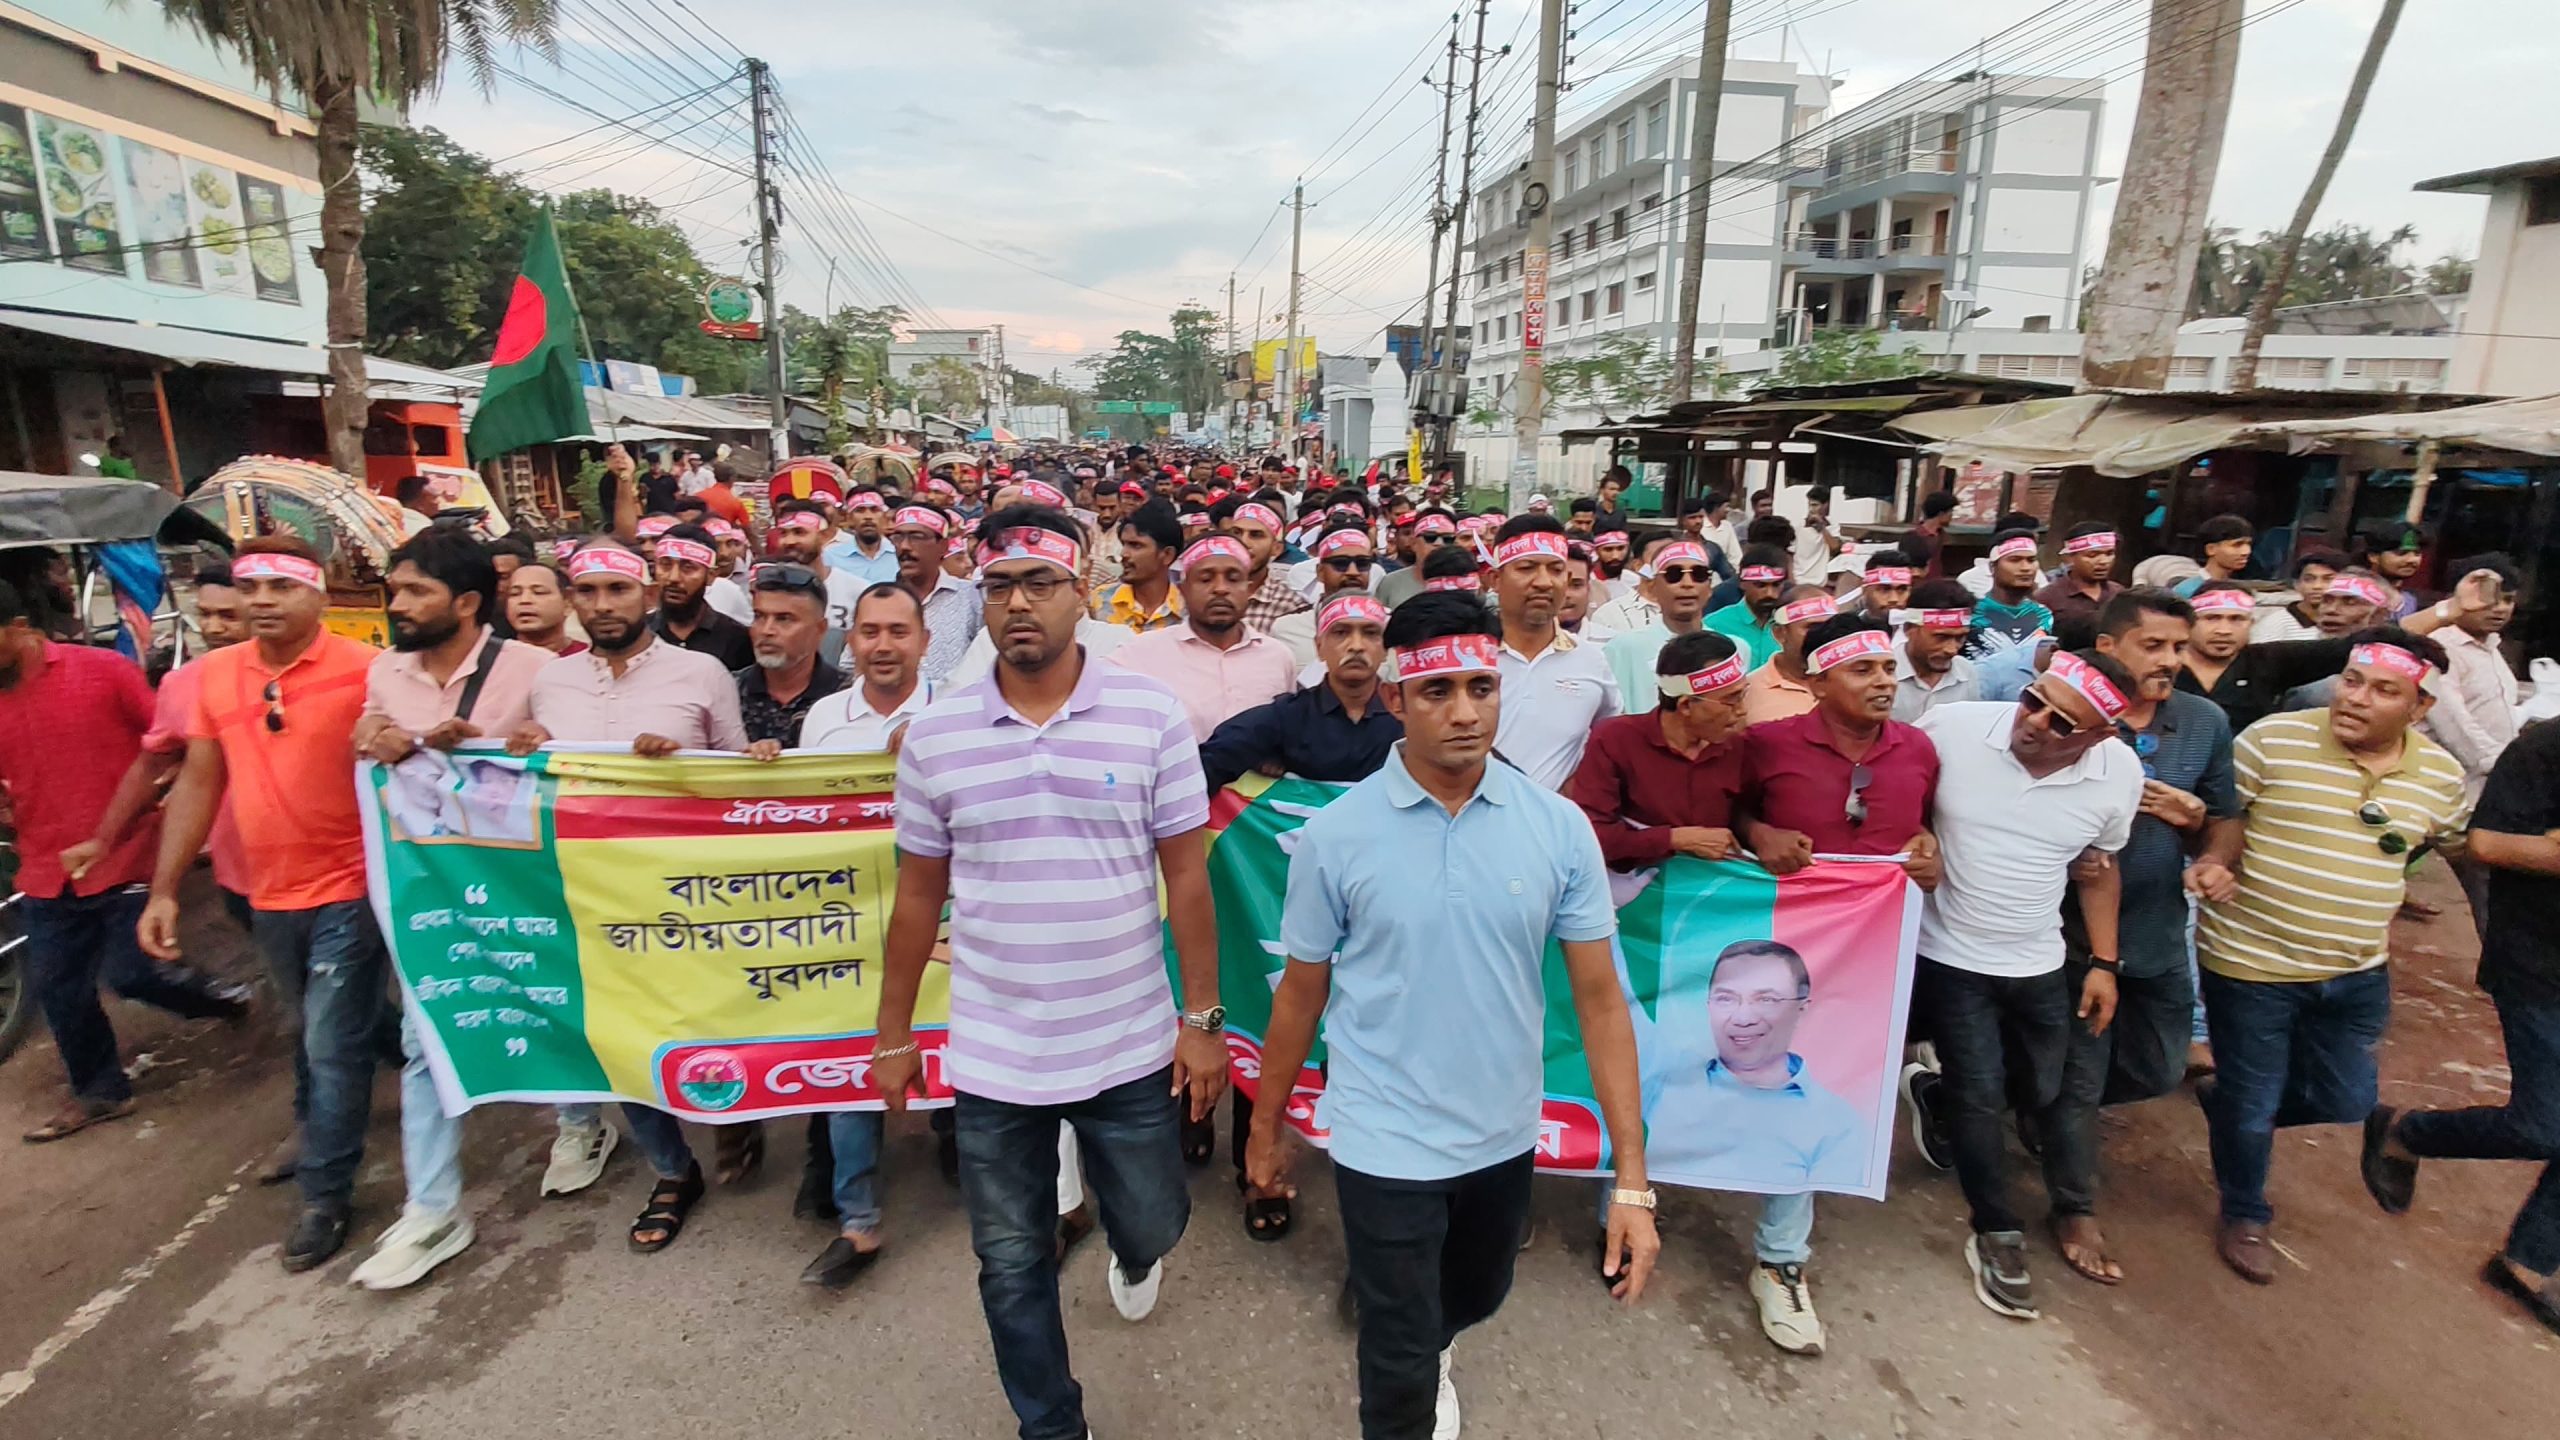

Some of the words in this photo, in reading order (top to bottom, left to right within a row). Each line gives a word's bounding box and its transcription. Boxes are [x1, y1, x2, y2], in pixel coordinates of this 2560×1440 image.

[664, 865, 861, 906] বাংলাদেশ
[601, 901, 865, 953] জাতীয়তাবাদী
[742, 958, 867, 1000] যুবদল
